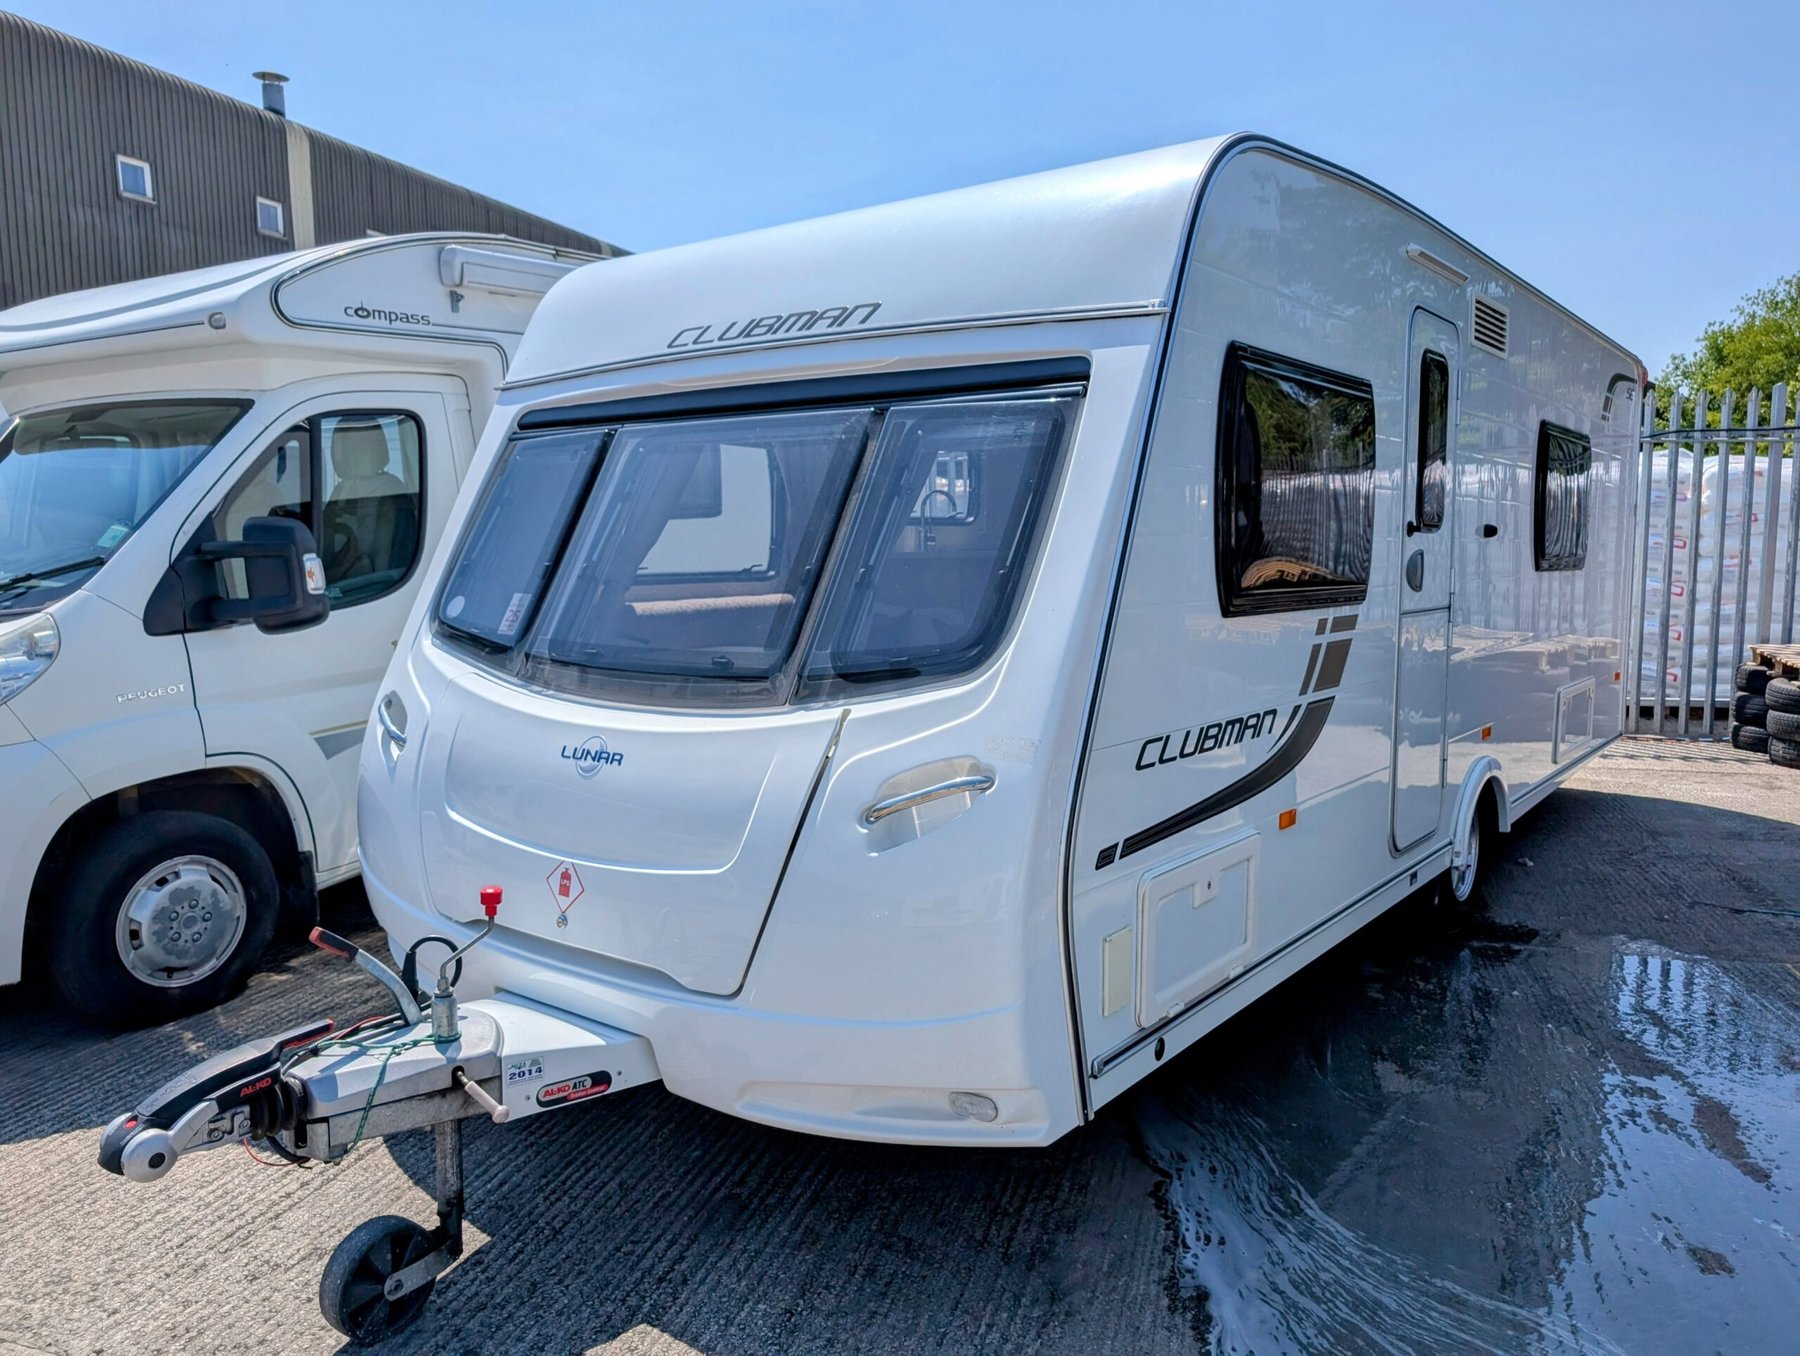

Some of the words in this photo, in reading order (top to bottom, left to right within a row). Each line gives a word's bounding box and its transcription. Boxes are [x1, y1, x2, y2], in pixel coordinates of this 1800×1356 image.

[343, 300, 431, 326] compass
[666, 301, 882, 349] CLUBMAN
[116, 683, 186, 704] PEUGEOT
[1135, 708, 1278, 771] CLUBMAN
[561, 744, 625, 767] LUNAR
[508, 1066, 543, 1081] 2014
[572, 1079, 588, 1091] ATC
